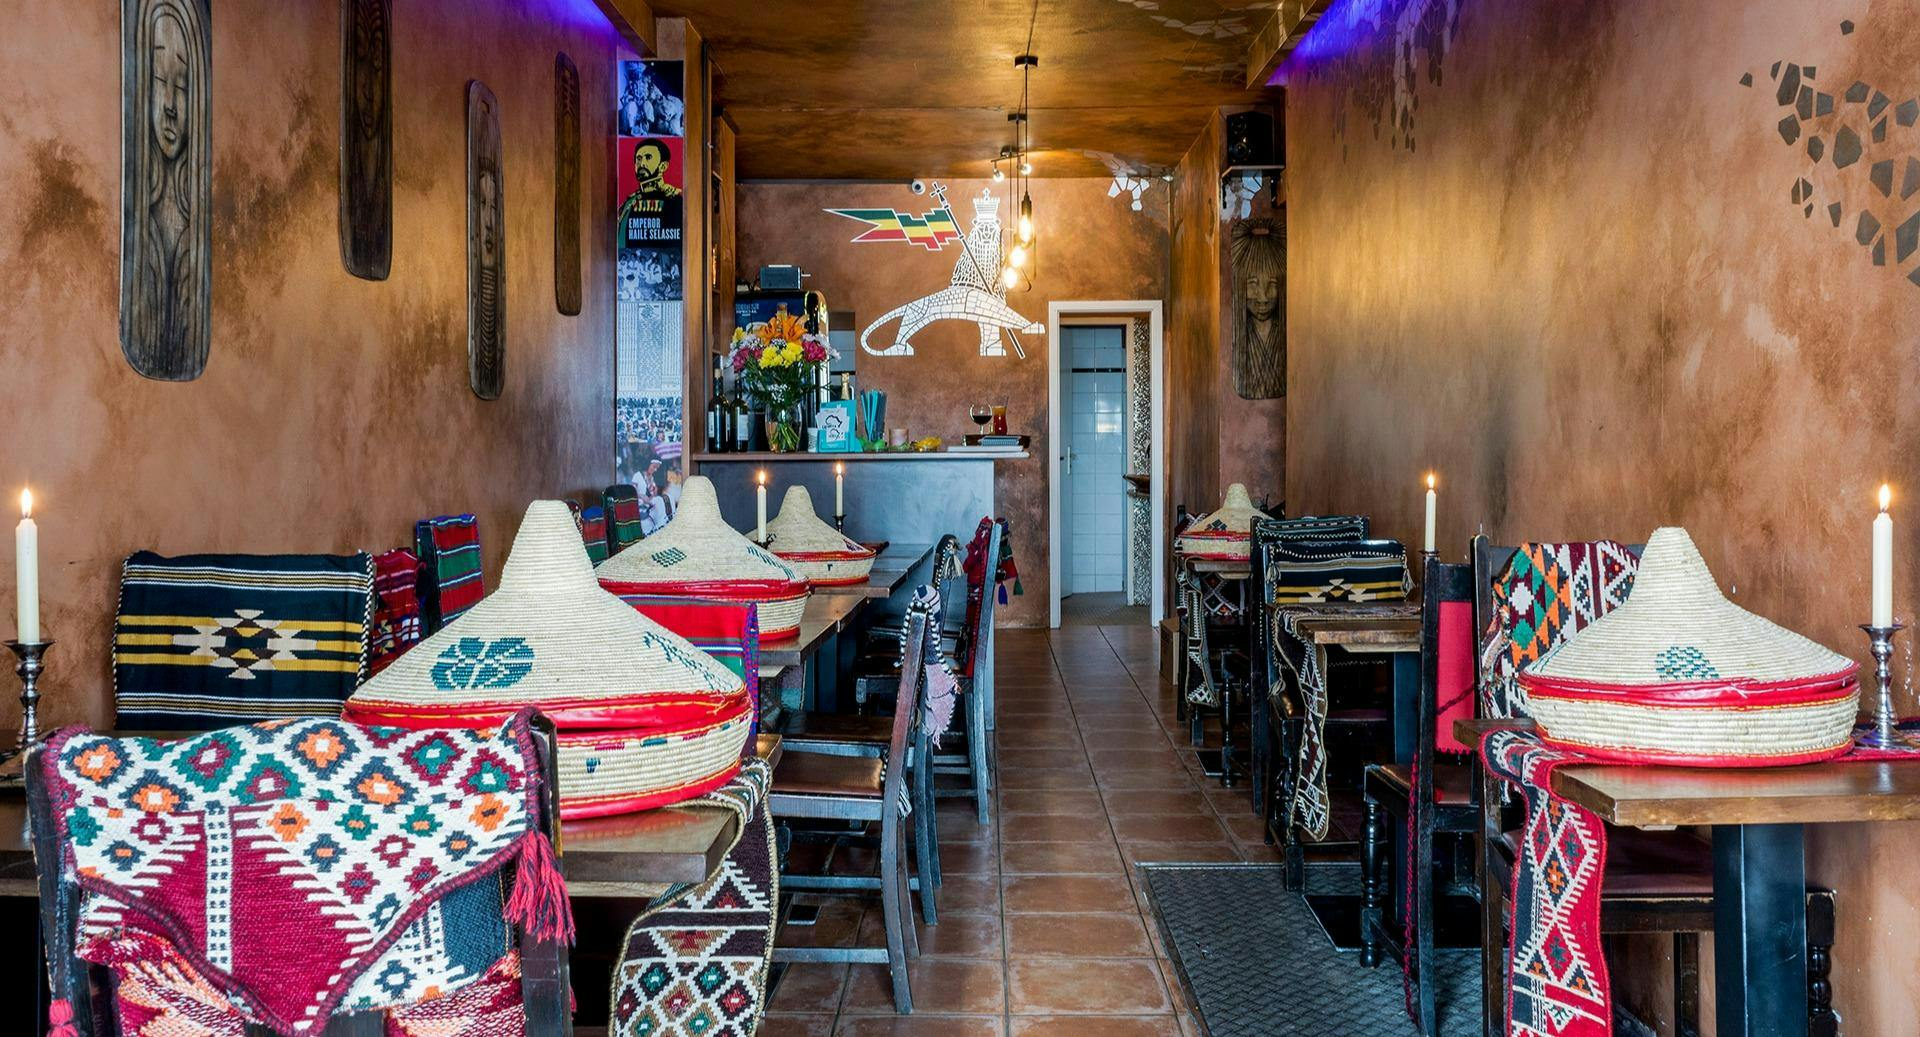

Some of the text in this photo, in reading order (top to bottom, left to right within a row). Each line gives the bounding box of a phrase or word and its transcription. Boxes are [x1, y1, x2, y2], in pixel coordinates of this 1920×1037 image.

[628, 217, 661, 229] EMPEROR
[628, 228, 681, 240] HAILE SELASSIE
